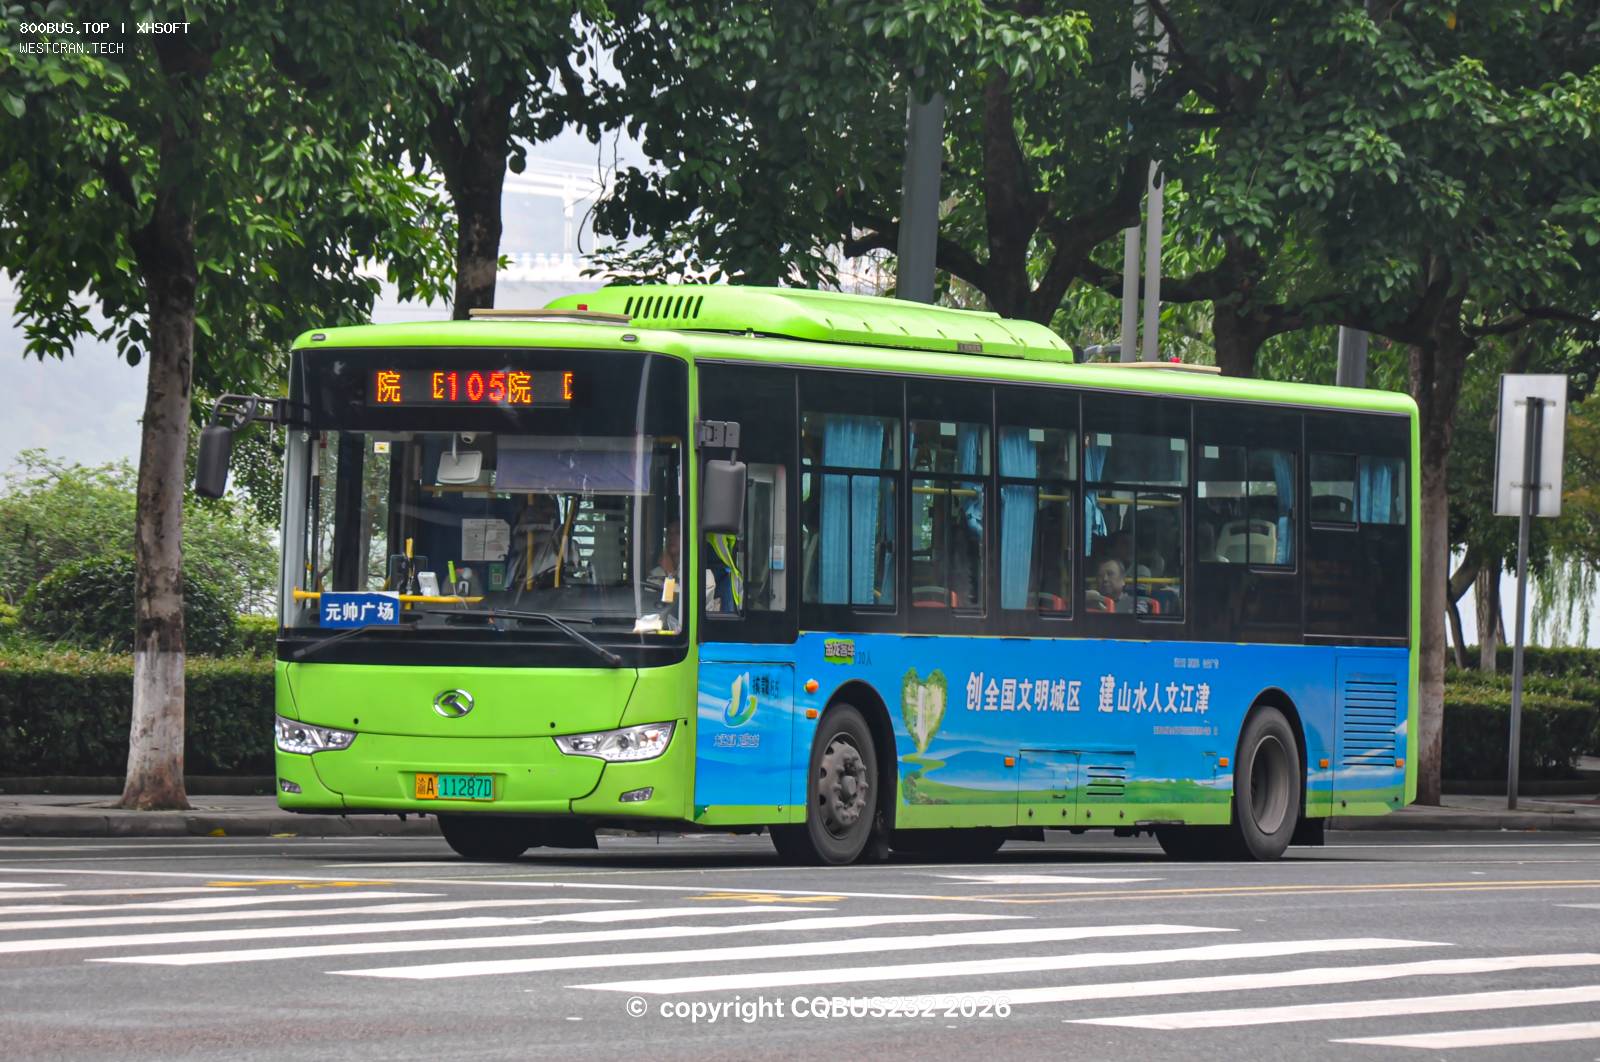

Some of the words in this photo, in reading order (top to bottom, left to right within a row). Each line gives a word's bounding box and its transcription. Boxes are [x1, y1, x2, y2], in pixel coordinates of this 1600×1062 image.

[377, 371, 401, 402] 院
[447, 372, 507, 401] 105
[508, 371, 532, 403] 院
[325, 601, 394, 621] 元帅广场
[965, 671, 1082, 712] 创全国文明城区
[1098, 674, 1211, 714] 建山水人文江津
